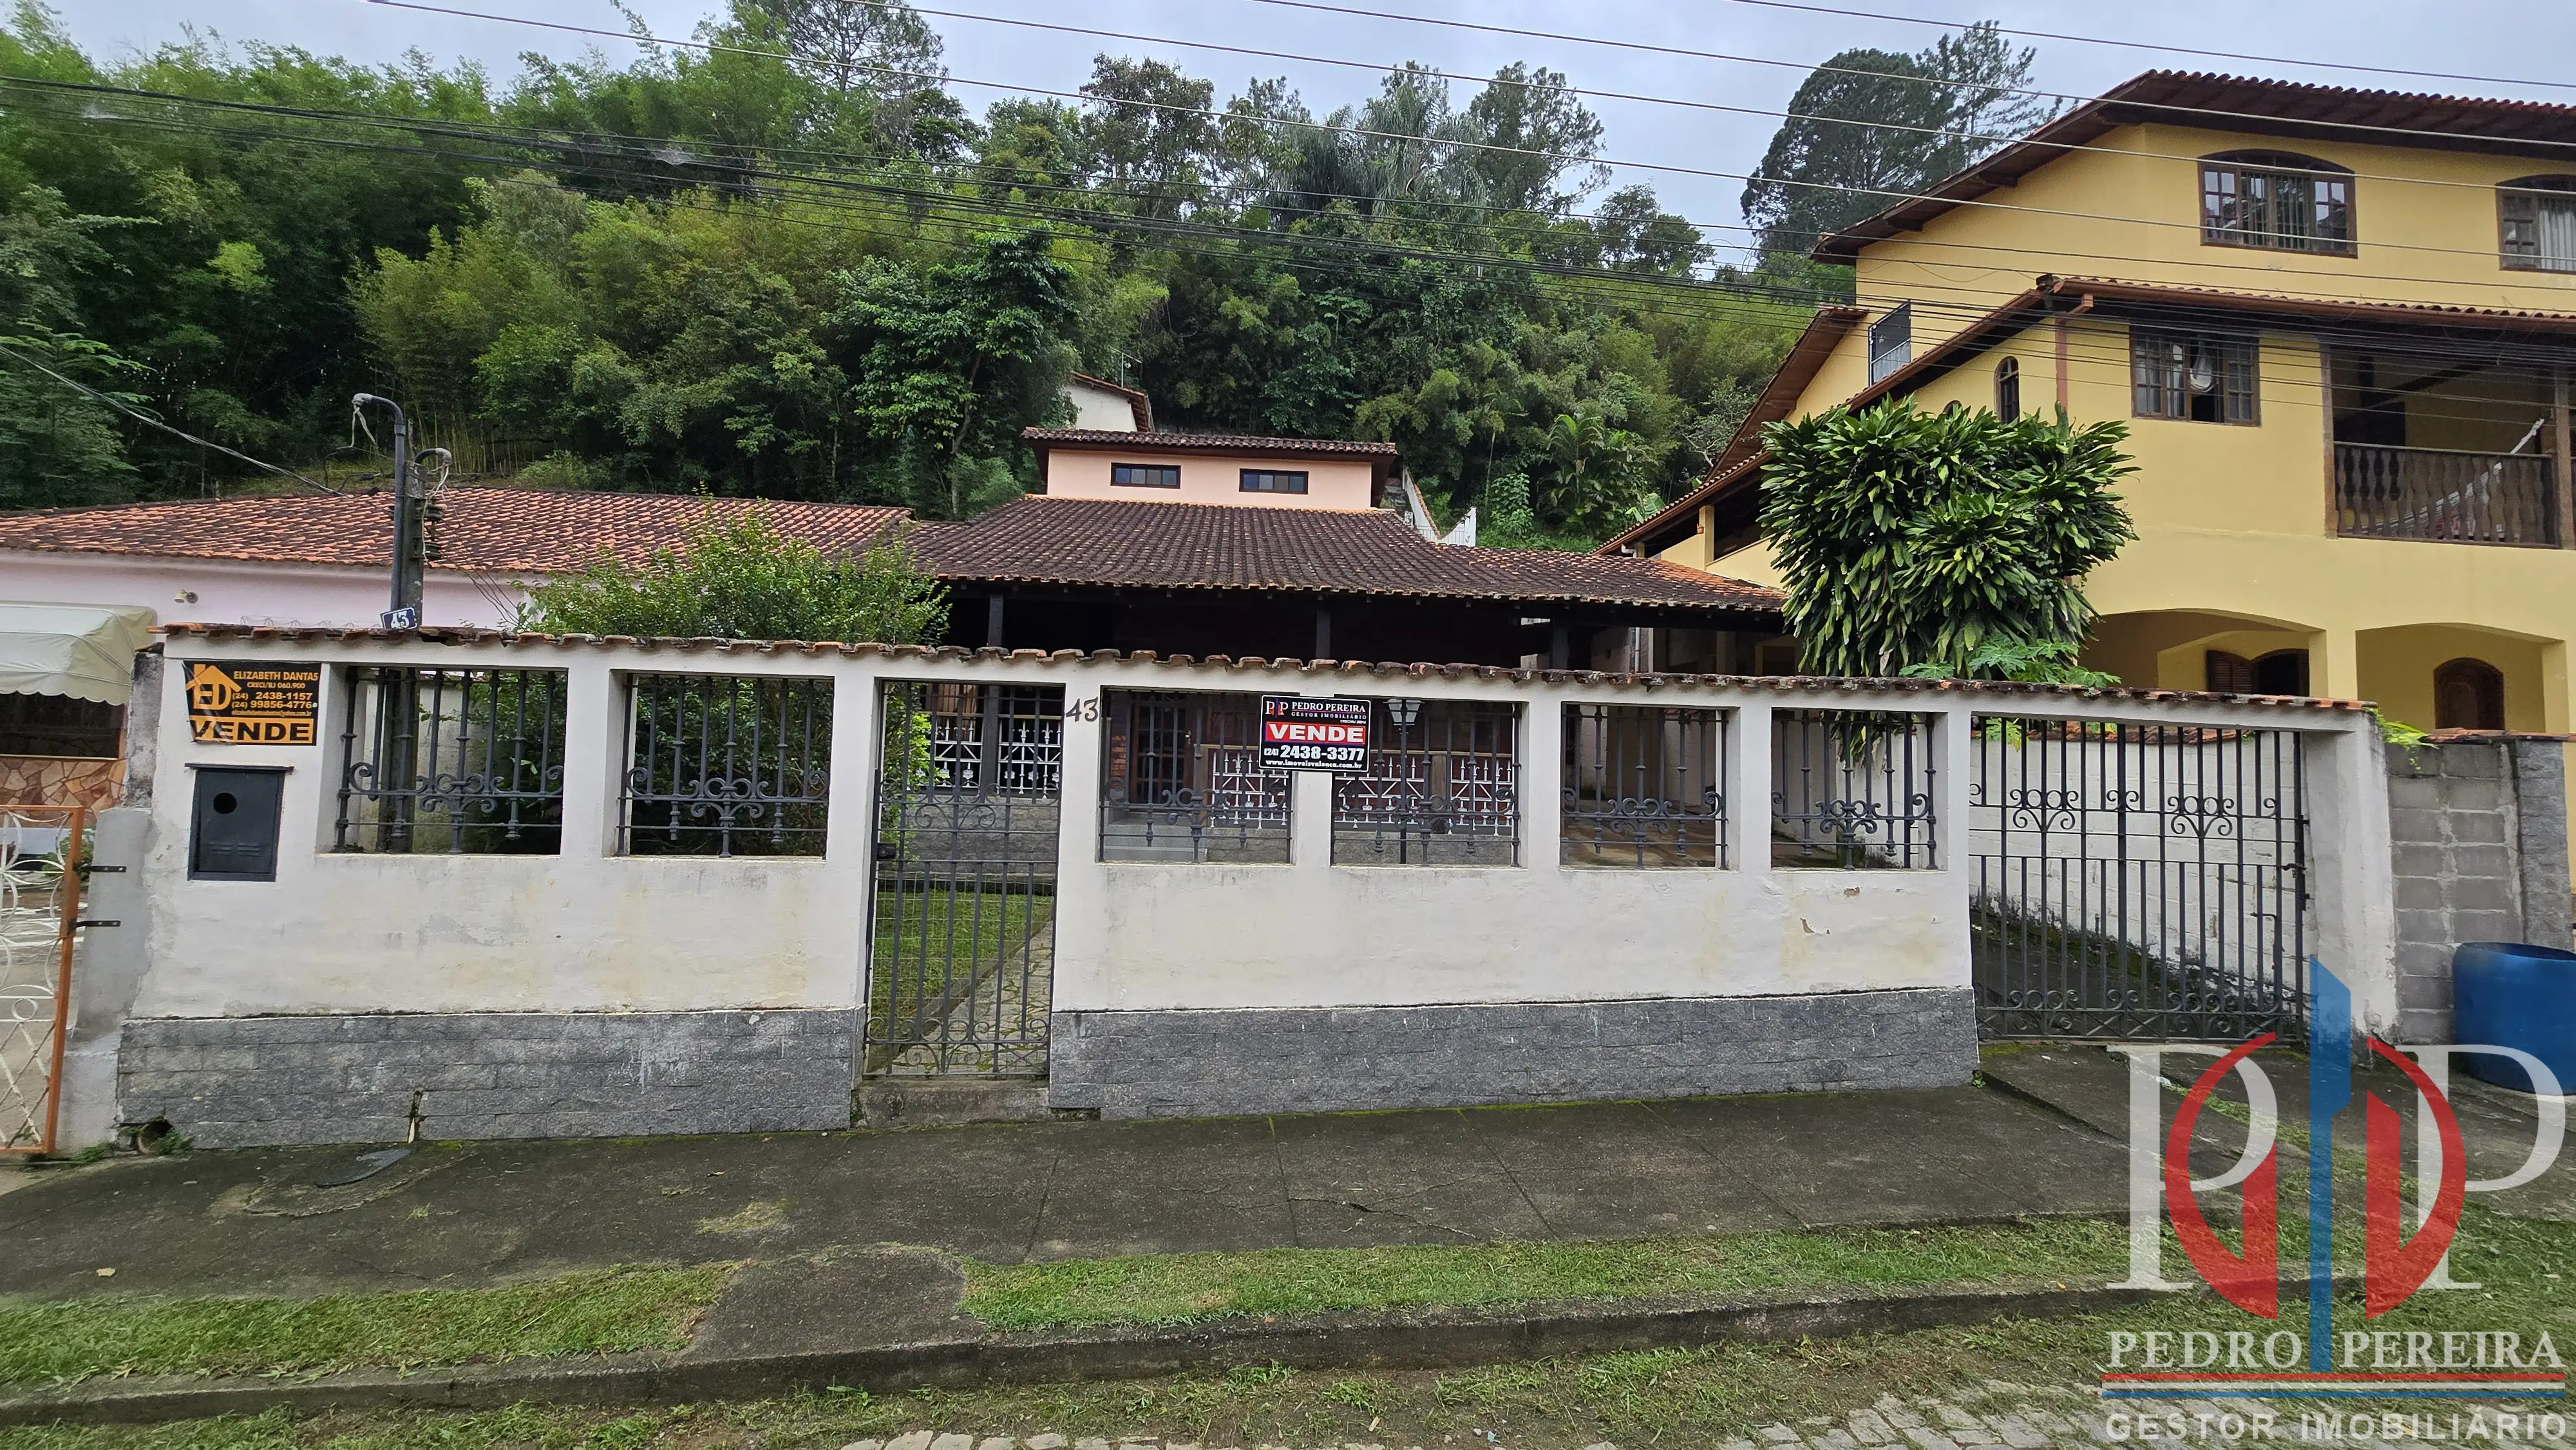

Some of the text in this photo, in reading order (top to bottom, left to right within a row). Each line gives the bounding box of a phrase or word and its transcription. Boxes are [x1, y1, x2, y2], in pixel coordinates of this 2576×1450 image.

[234, 671, 318, 681] ELIZABETH DANTAS
[232, 692, 313, 701] (24) 2438-1157
[232, 700, 312, 709] (24) 99856-4776
[1065, 696, 1099, 722] 43
[1291, 702, 1365, 713] PEDRO PEREIRA
[189, 719, 310, 741] VENDE
[1269, 724, 1364, 742] VENDE
[1280, 744, 1365, 761] 2438-3377
